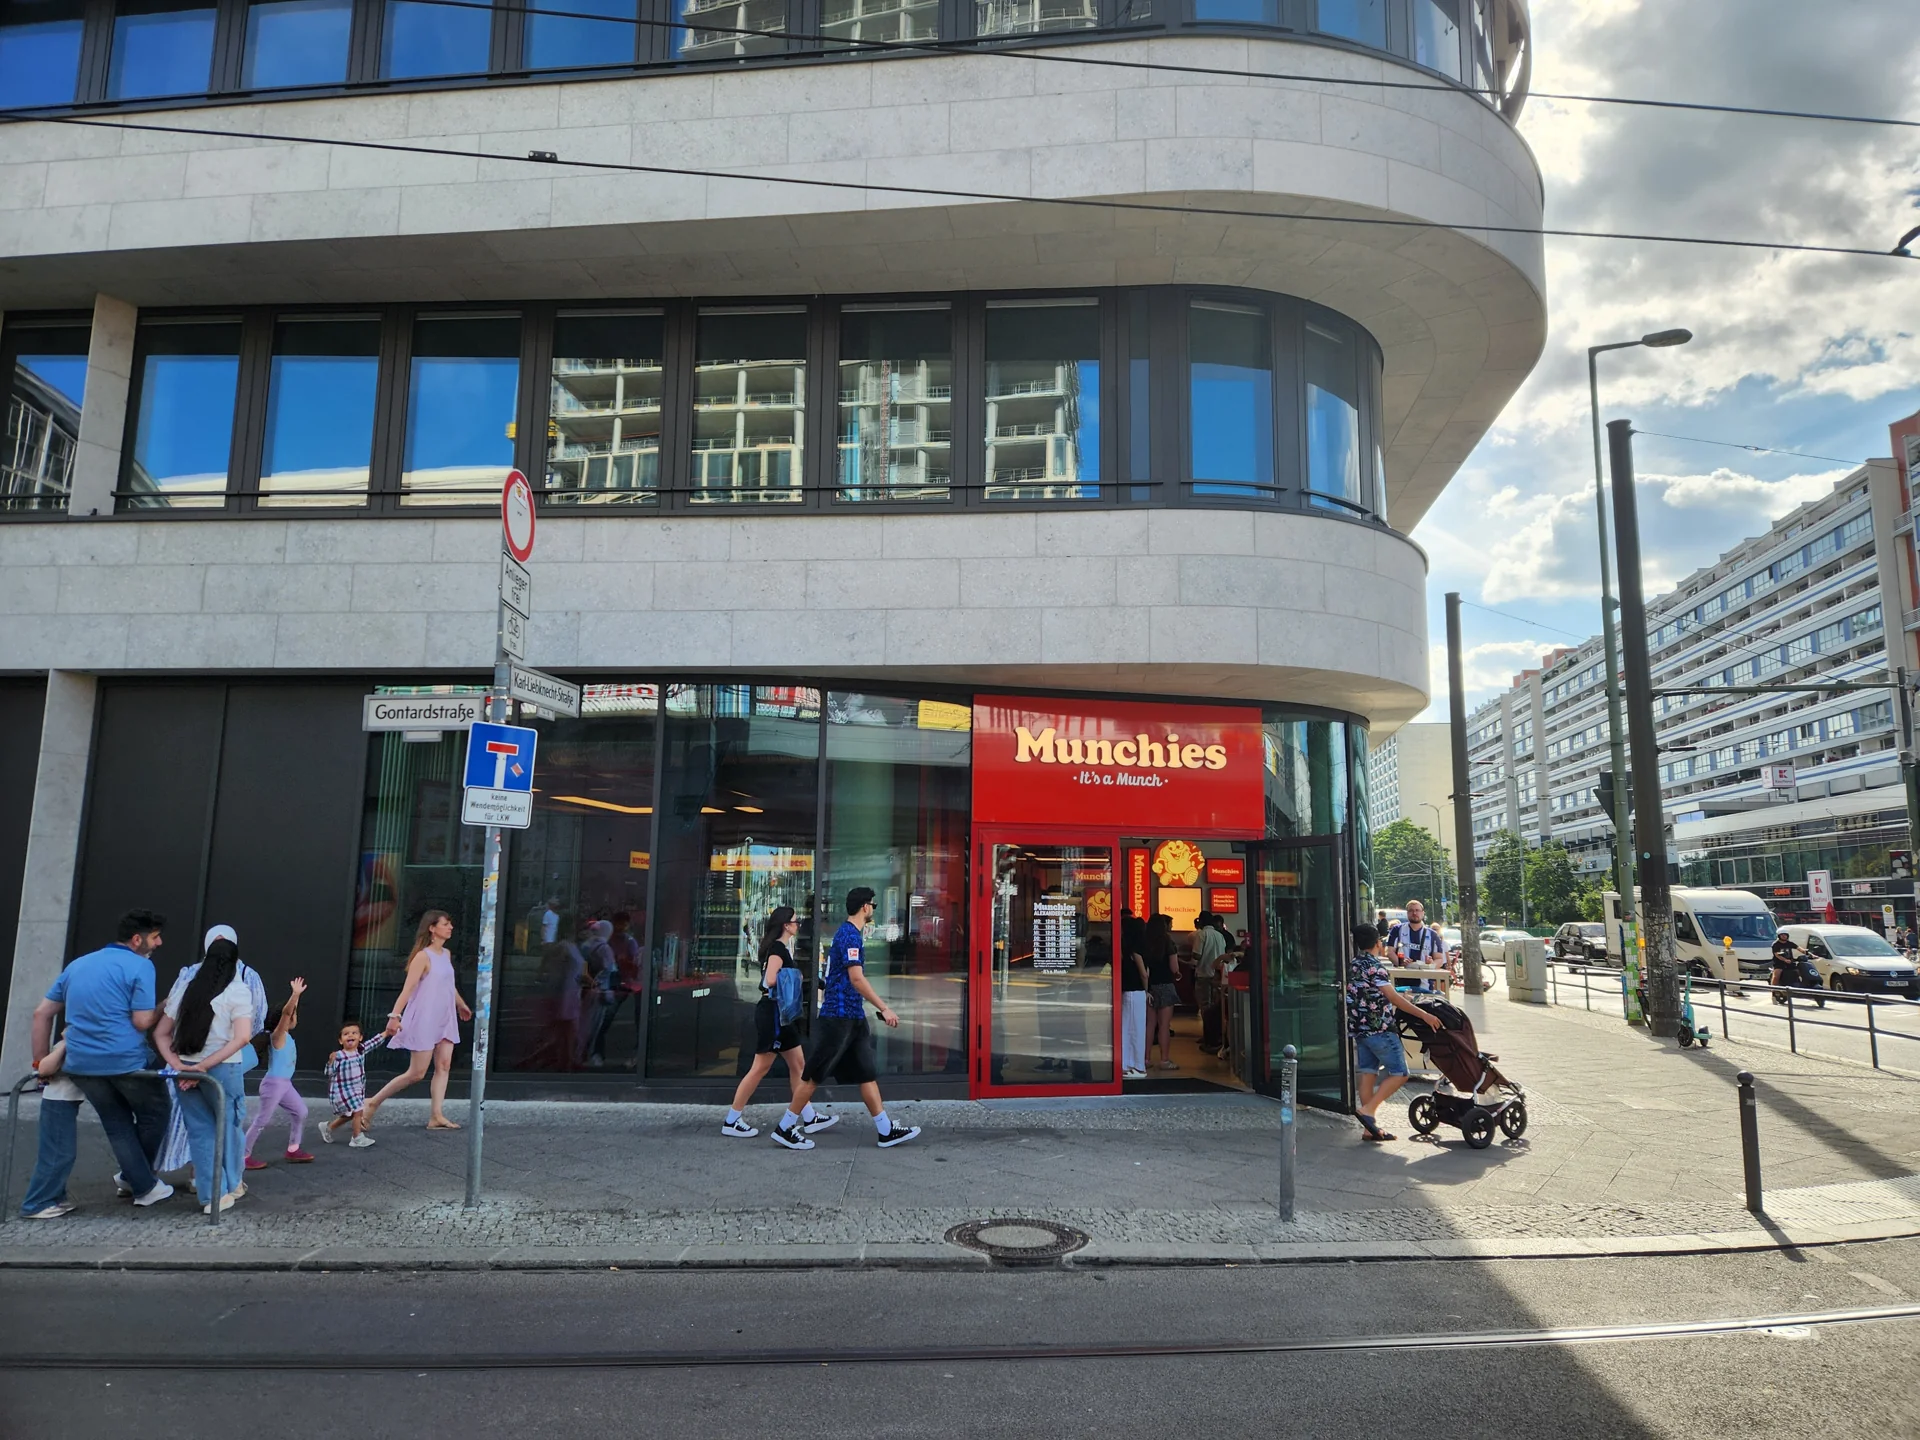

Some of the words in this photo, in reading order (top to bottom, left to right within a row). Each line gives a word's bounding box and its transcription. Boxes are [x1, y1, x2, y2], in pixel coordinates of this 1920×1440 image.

[505, 563, 528, 592] Anlieger
[511, 586, 521, 605] frei
[509, 637, 517, 650] frei
[514, 672, 574, 708] Karl-Liebknecht-Straße
[375, 703, 475, 722] Gontardstraße
[1014, 726, 1228, 770] Munchies
[1079, 771, 1100, 785] It's
[1103, 774, 1114, 785] a
[1116, 772, 1163, 787] Munch
[491, 792, 508, 801] keine
[470, 801, 526, 813] Wendemöglichkeit
[484, 812, 494, 820] für
[496, 813, 510, 821] LKW
[1134, 855, 1145, 918] Munchies
